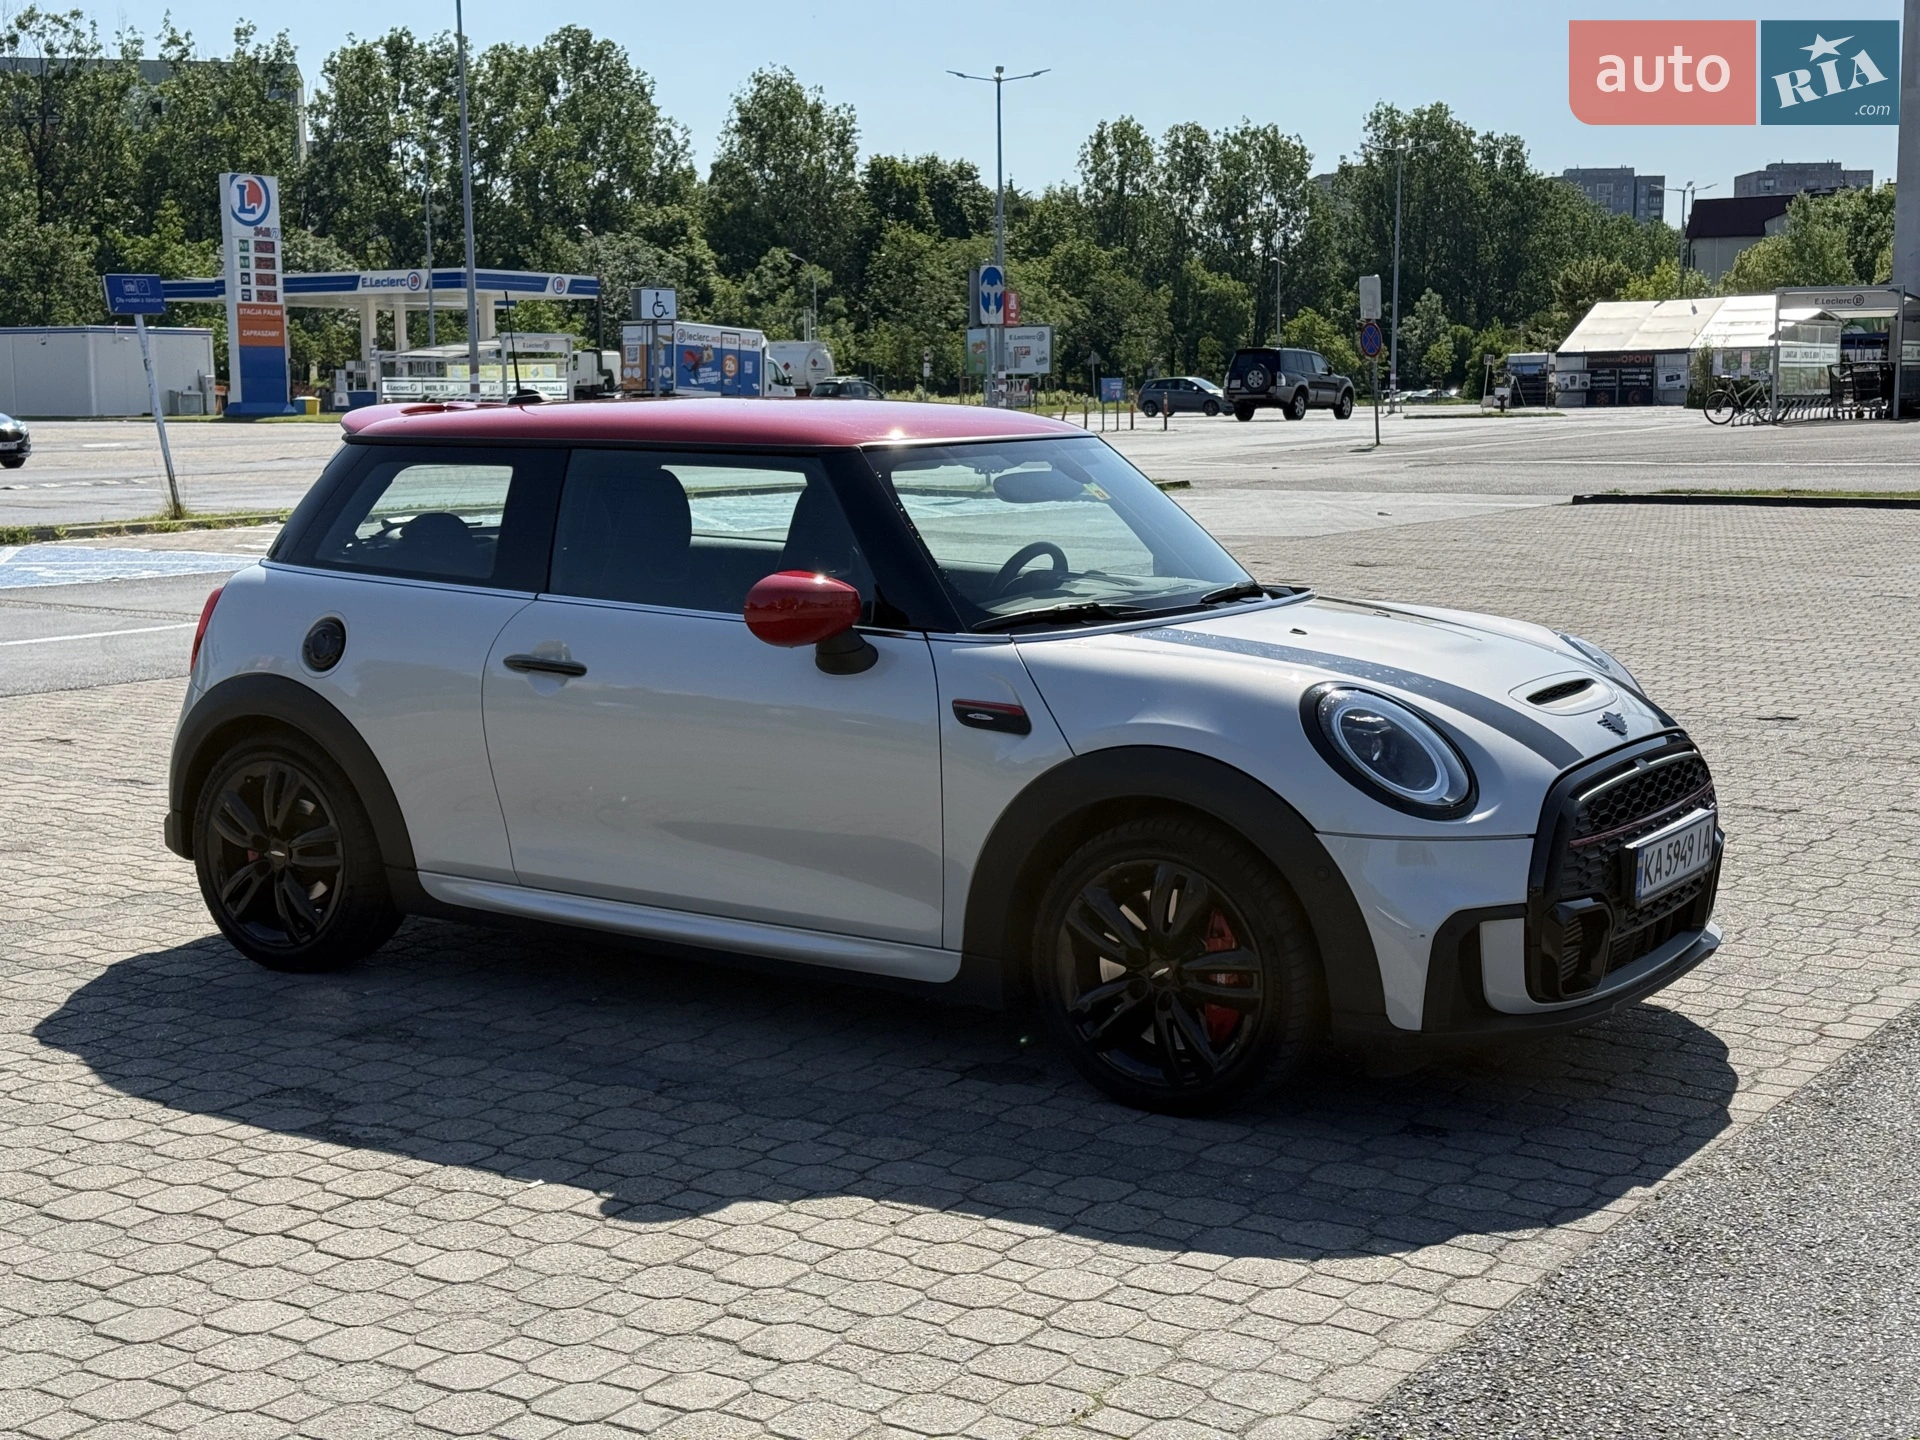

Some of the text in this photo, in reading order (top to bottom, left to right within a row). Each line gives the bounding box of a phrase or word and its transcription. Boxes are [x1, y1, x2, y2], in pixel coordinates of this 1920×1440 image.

[361, 276, 407, 288] E.Leclerc
[239, 308, 262, 316] STACJA
[242, 329, 280, 337] ZAPRASZAMY
[1621, 354, 1654, 363] OPONY
[1643, 824, 1710, 889] KA 5949 IA
